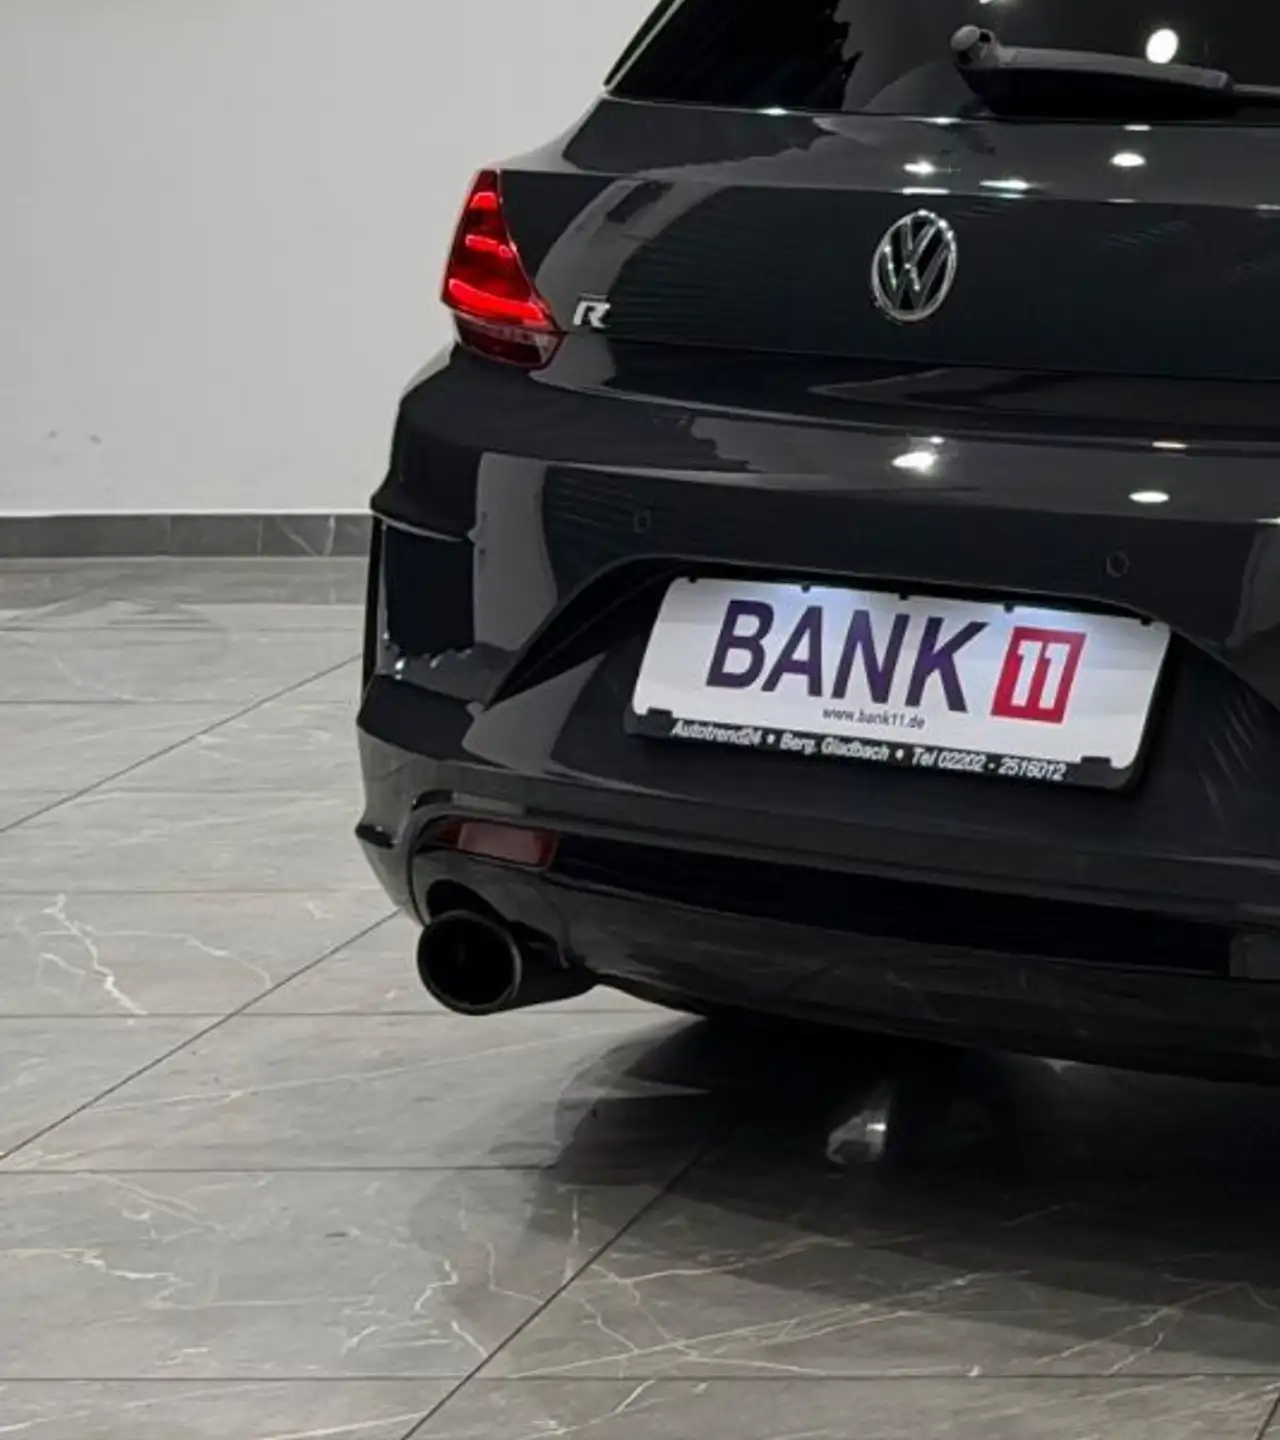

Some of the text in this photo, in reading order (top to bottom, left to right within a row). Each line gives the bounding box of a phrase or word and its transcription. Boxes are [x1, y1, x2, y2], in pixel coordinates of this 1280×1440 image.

[572, 294, 611, 329] R
[705, 599, 1072, 713] BANK 11
[821, 706, 926, 730] www.bank11.de
[670, 719, 762, 746] Autotrend24
[821, 736, 890, 762] Gladbach
[912, 747, 936, 768] Tel
